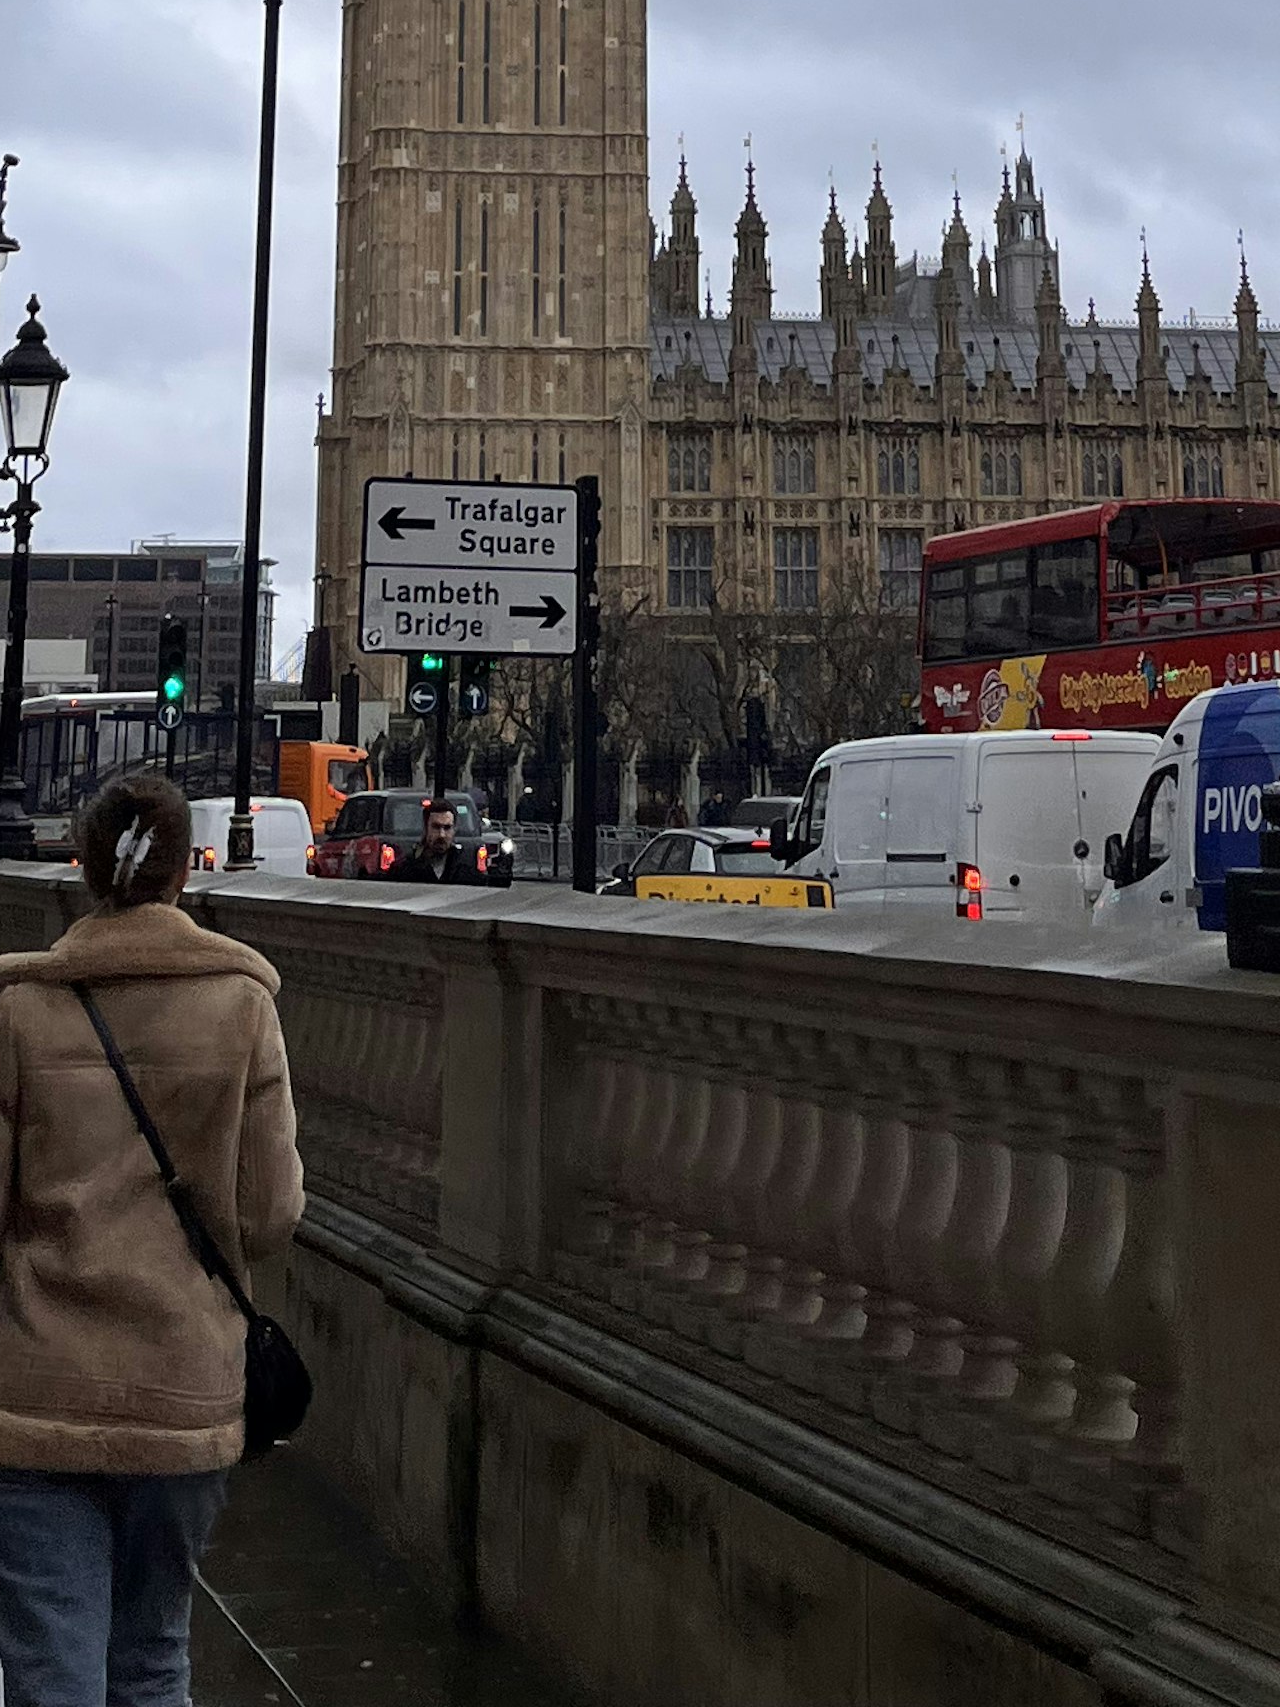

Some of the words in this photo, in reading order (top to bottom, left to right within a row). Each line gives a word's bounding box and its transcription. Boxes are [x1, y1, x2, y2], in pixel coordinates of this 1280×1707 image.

[445, 496, 567, 528] Trafalgar
[458, 528, 556, 558] Square
[381, 578, 499, 606] Lambeth
[395, 611, 483, 642] Bridge
